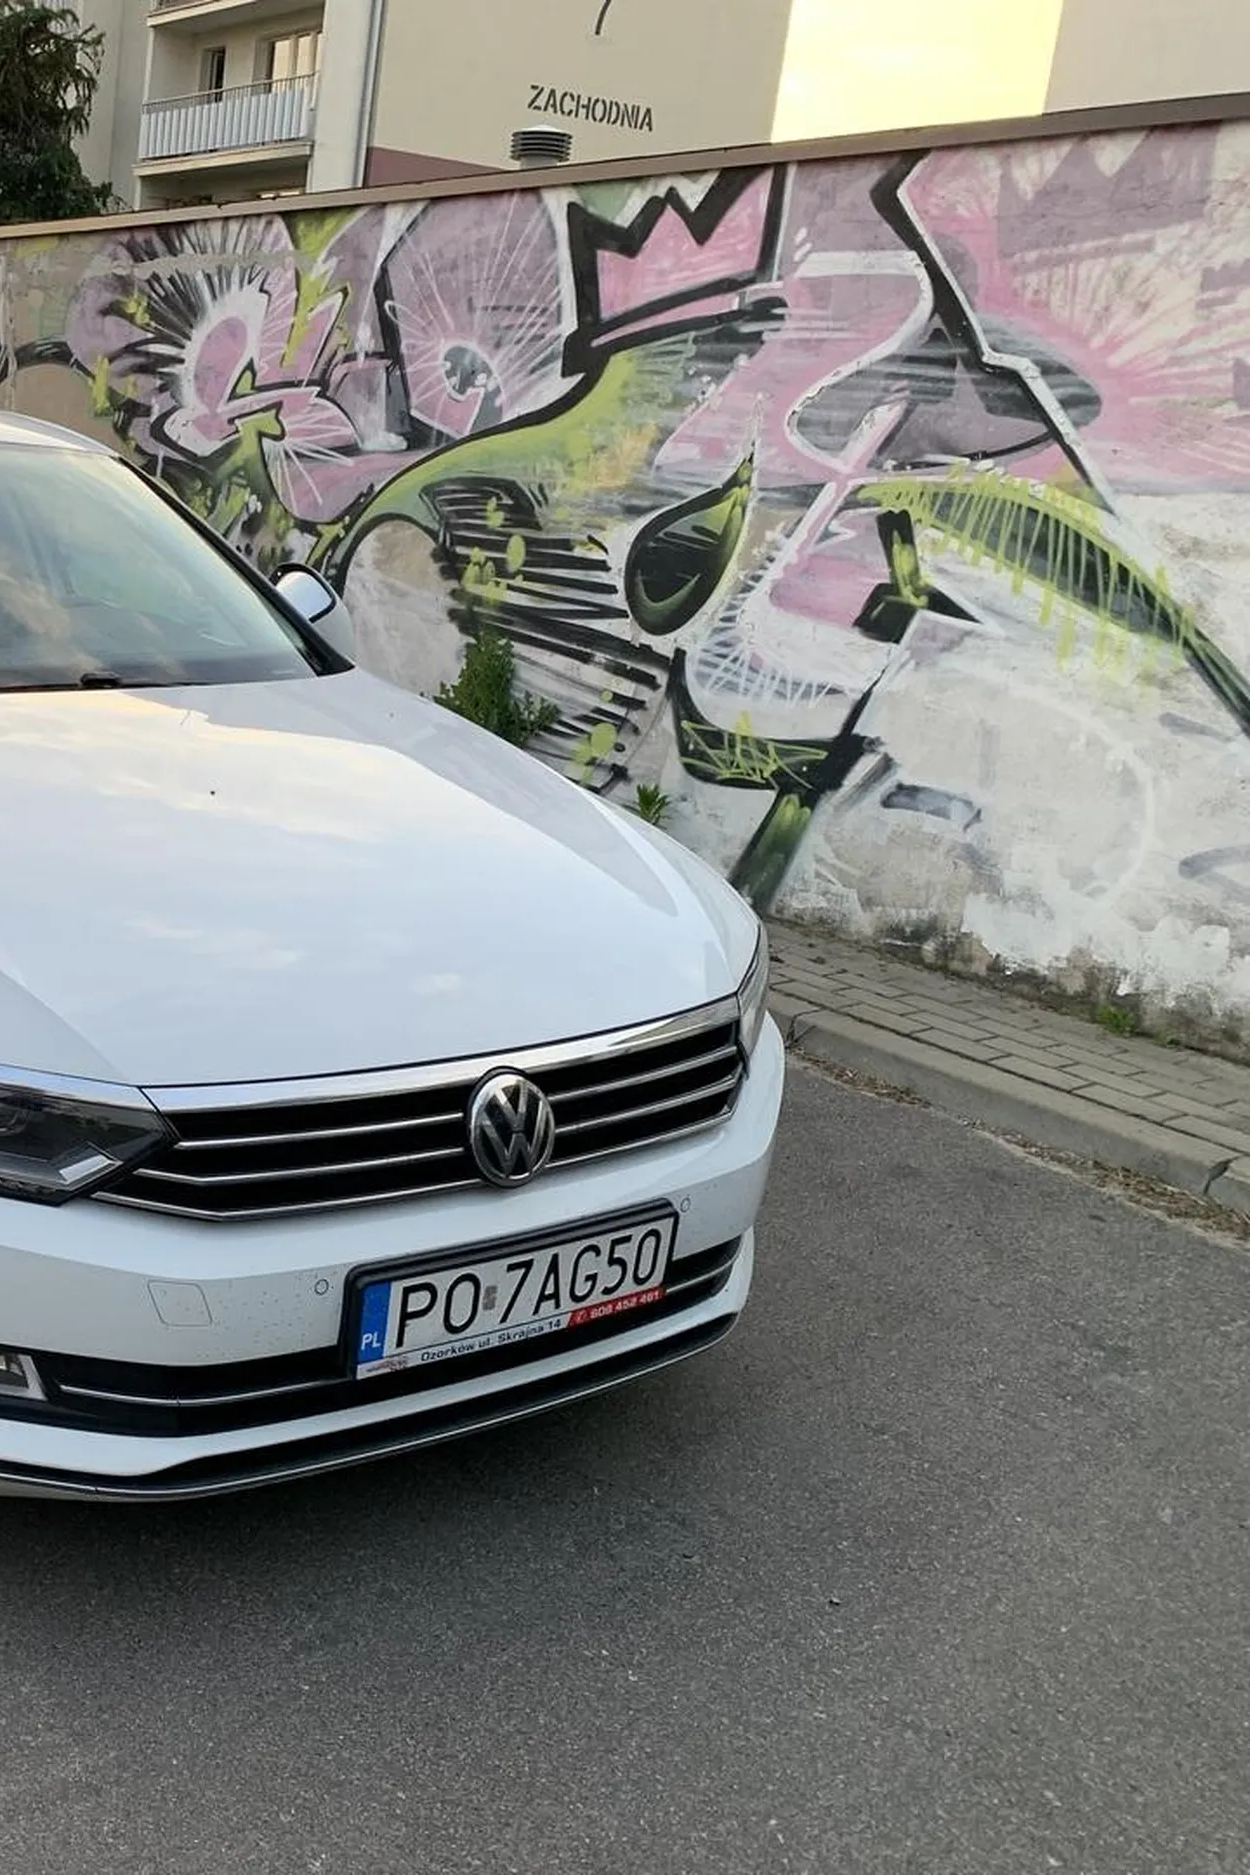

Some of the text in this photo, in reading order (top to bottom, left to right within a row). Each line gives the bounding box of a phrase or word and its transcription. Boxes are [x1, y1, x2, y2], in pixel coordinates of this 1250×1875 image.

[527, 84, 654, 132] ZACHODNIA
[395, 1228, 662, 1348] PO 7AG50
[361, 1332, 381, 1350] PL
[421, 1343, 475, 1361] Ozorków
[498, 1325, 544, 1343] Skrajna
[549, 1319, 561, 1329] 14
